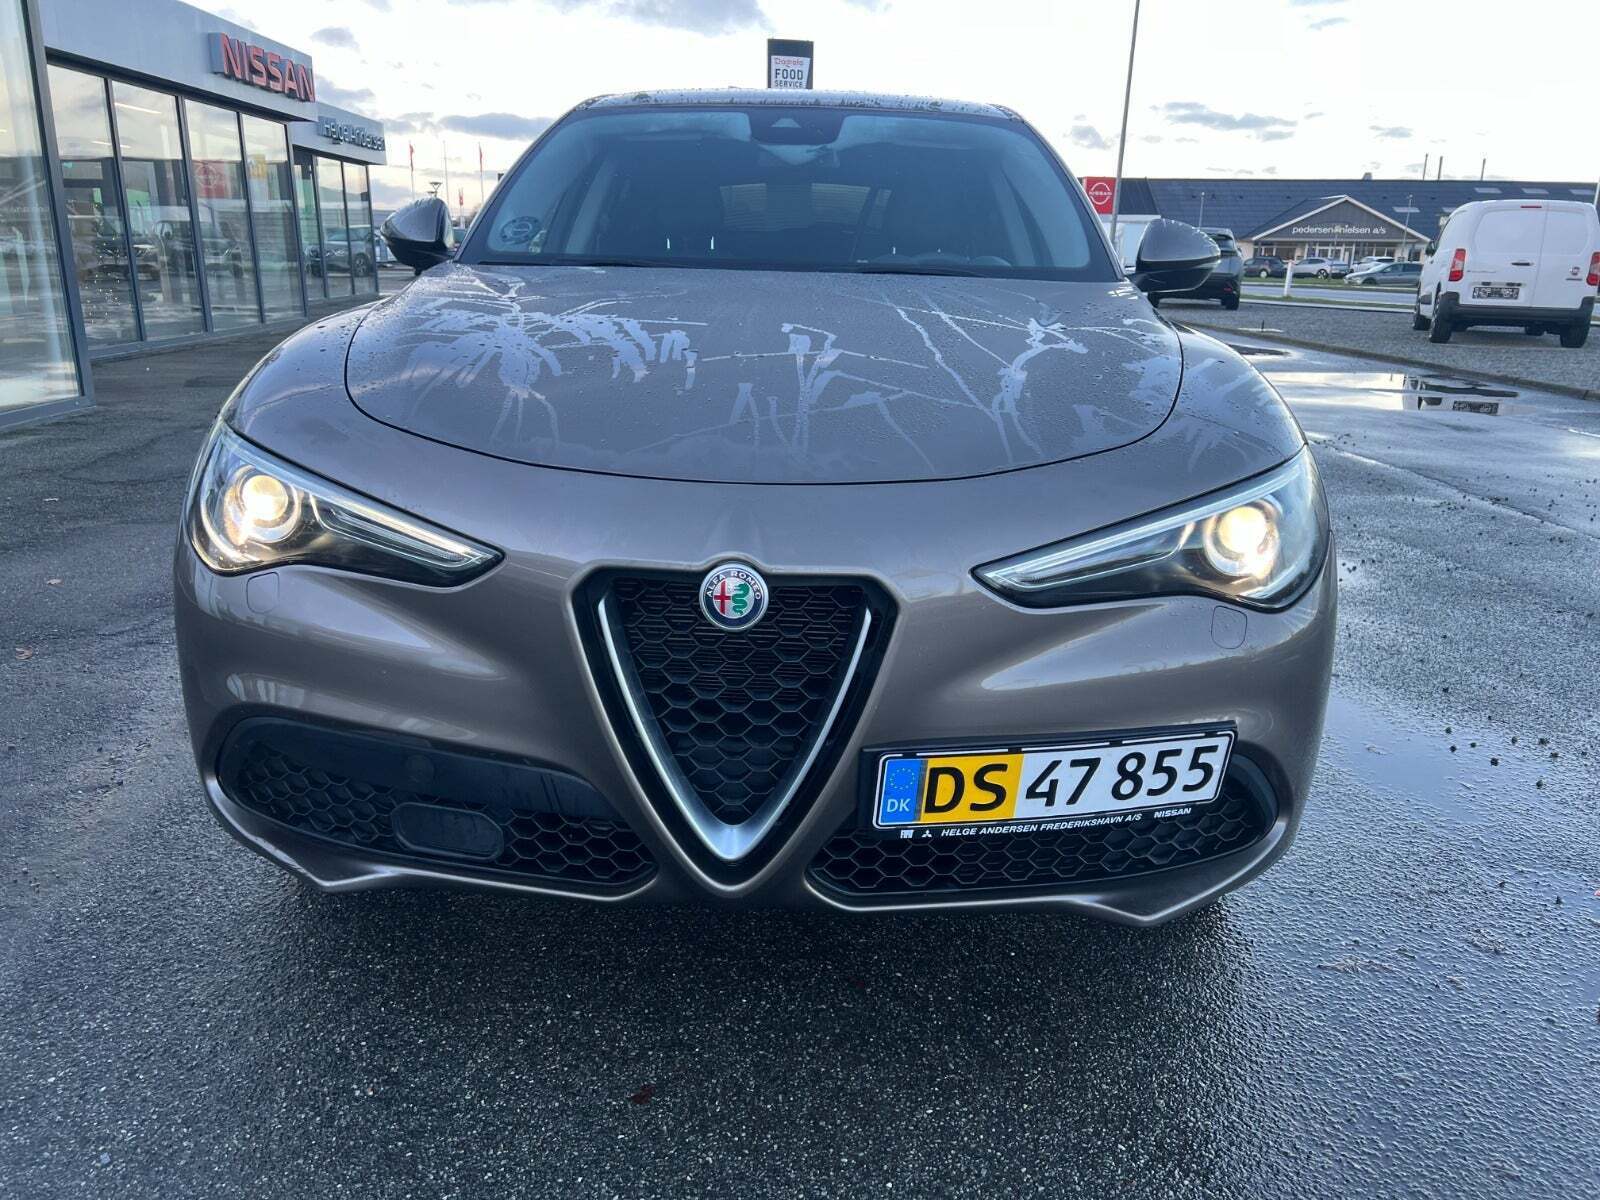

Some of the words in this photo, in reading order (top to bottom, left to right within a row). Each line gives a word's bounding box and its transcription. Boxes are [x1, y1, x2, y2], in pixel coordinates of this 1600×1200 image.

[221, 31, 315, 102] NISSAN
[775, 68, 803, 80] FOOD
[774, 80, 803, 88] SERVICE
[706, 574, 726, 598] ALFA
[730, 570, 762, 600] ROMEO
[924, 763, 1008, 814] DS
[1025, 757, 1101, 807] 47
[1111, 745, 1219, 801] 855
[887, 798, 910, 813] DK
[1153, 807, 1192, 819] NISSAN
[941, 827, 978, 837] HELGE
[981, 824, 1038, 835] ANDERSEN
[1040, 815, 1124, 831] FREDERIKSHAVN
[1124, 813, 1142, 822] A/S
